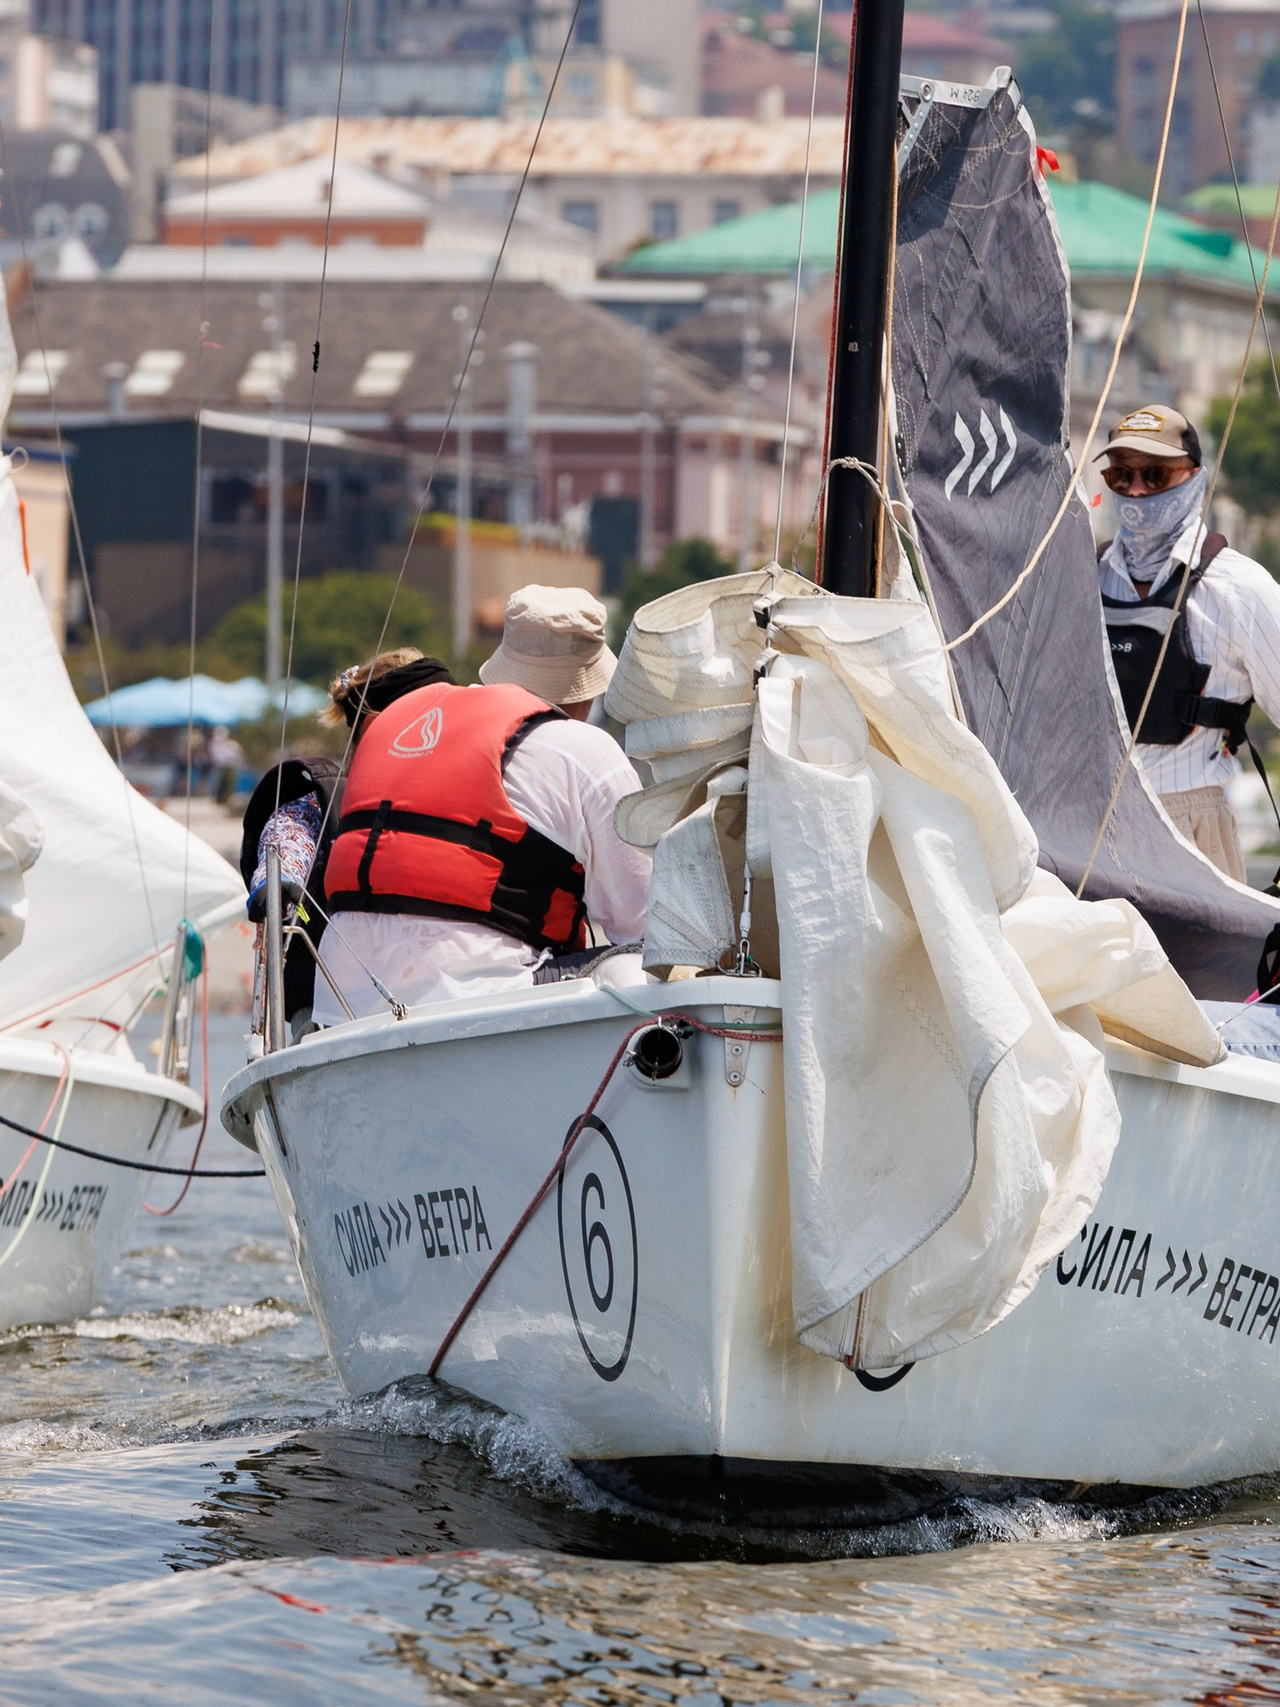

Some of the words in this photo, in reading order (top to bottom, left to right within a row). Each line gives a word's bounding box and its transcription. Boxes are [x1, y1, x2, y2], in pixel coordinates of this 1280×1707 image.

[0, 1178, 40, 1227] ИЛА
[59, 1185, 108, 1231] ВЕТРА
[334, 1201, 386, 1278] СИЛА
[414, 1185, 492, 1259] ВЕТРА
[581, 1172, 614, 1313] 6
